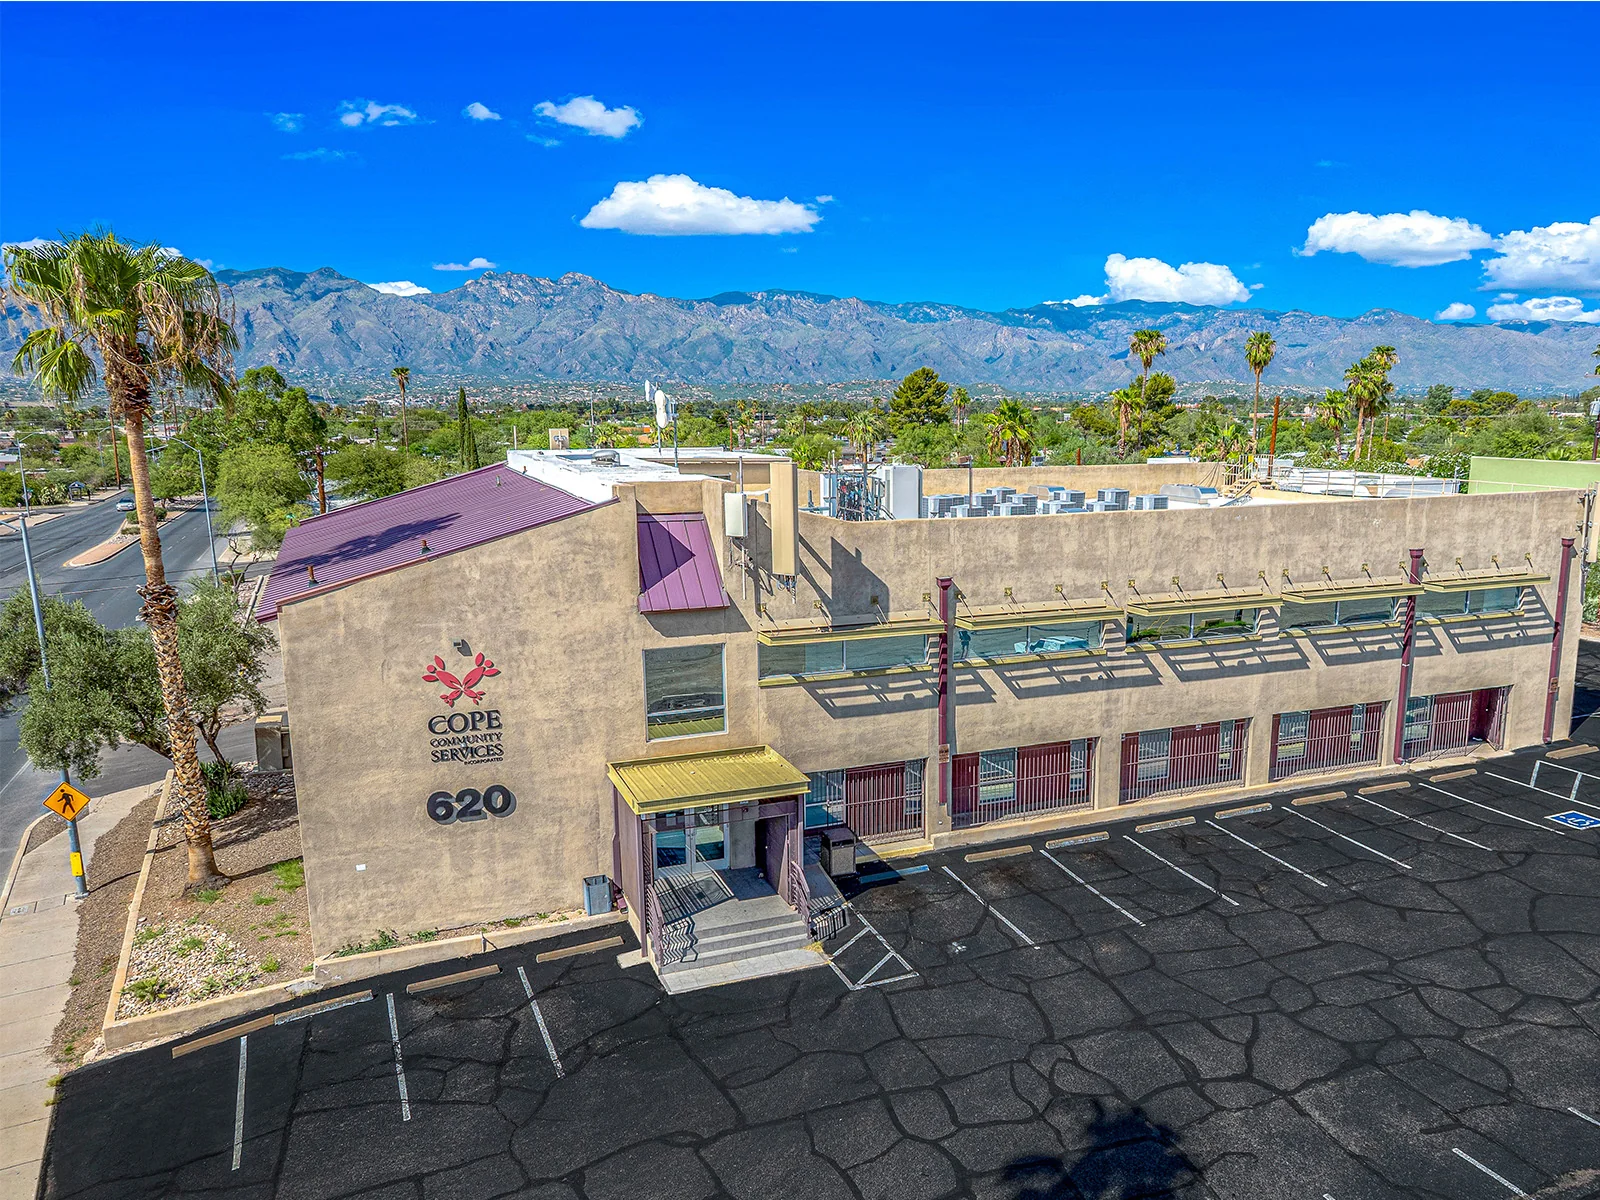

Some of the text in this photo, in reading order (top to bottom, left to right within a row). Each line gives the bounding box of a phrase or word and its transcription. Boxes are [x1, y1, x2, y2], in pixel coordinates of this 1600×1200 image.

[428, 709, 503, 735] COPE
[430, 732, 503, 748] COMMUNITY
[431, 743, 504, 763] SERVICES
[427, 784, 514, 824] 620
